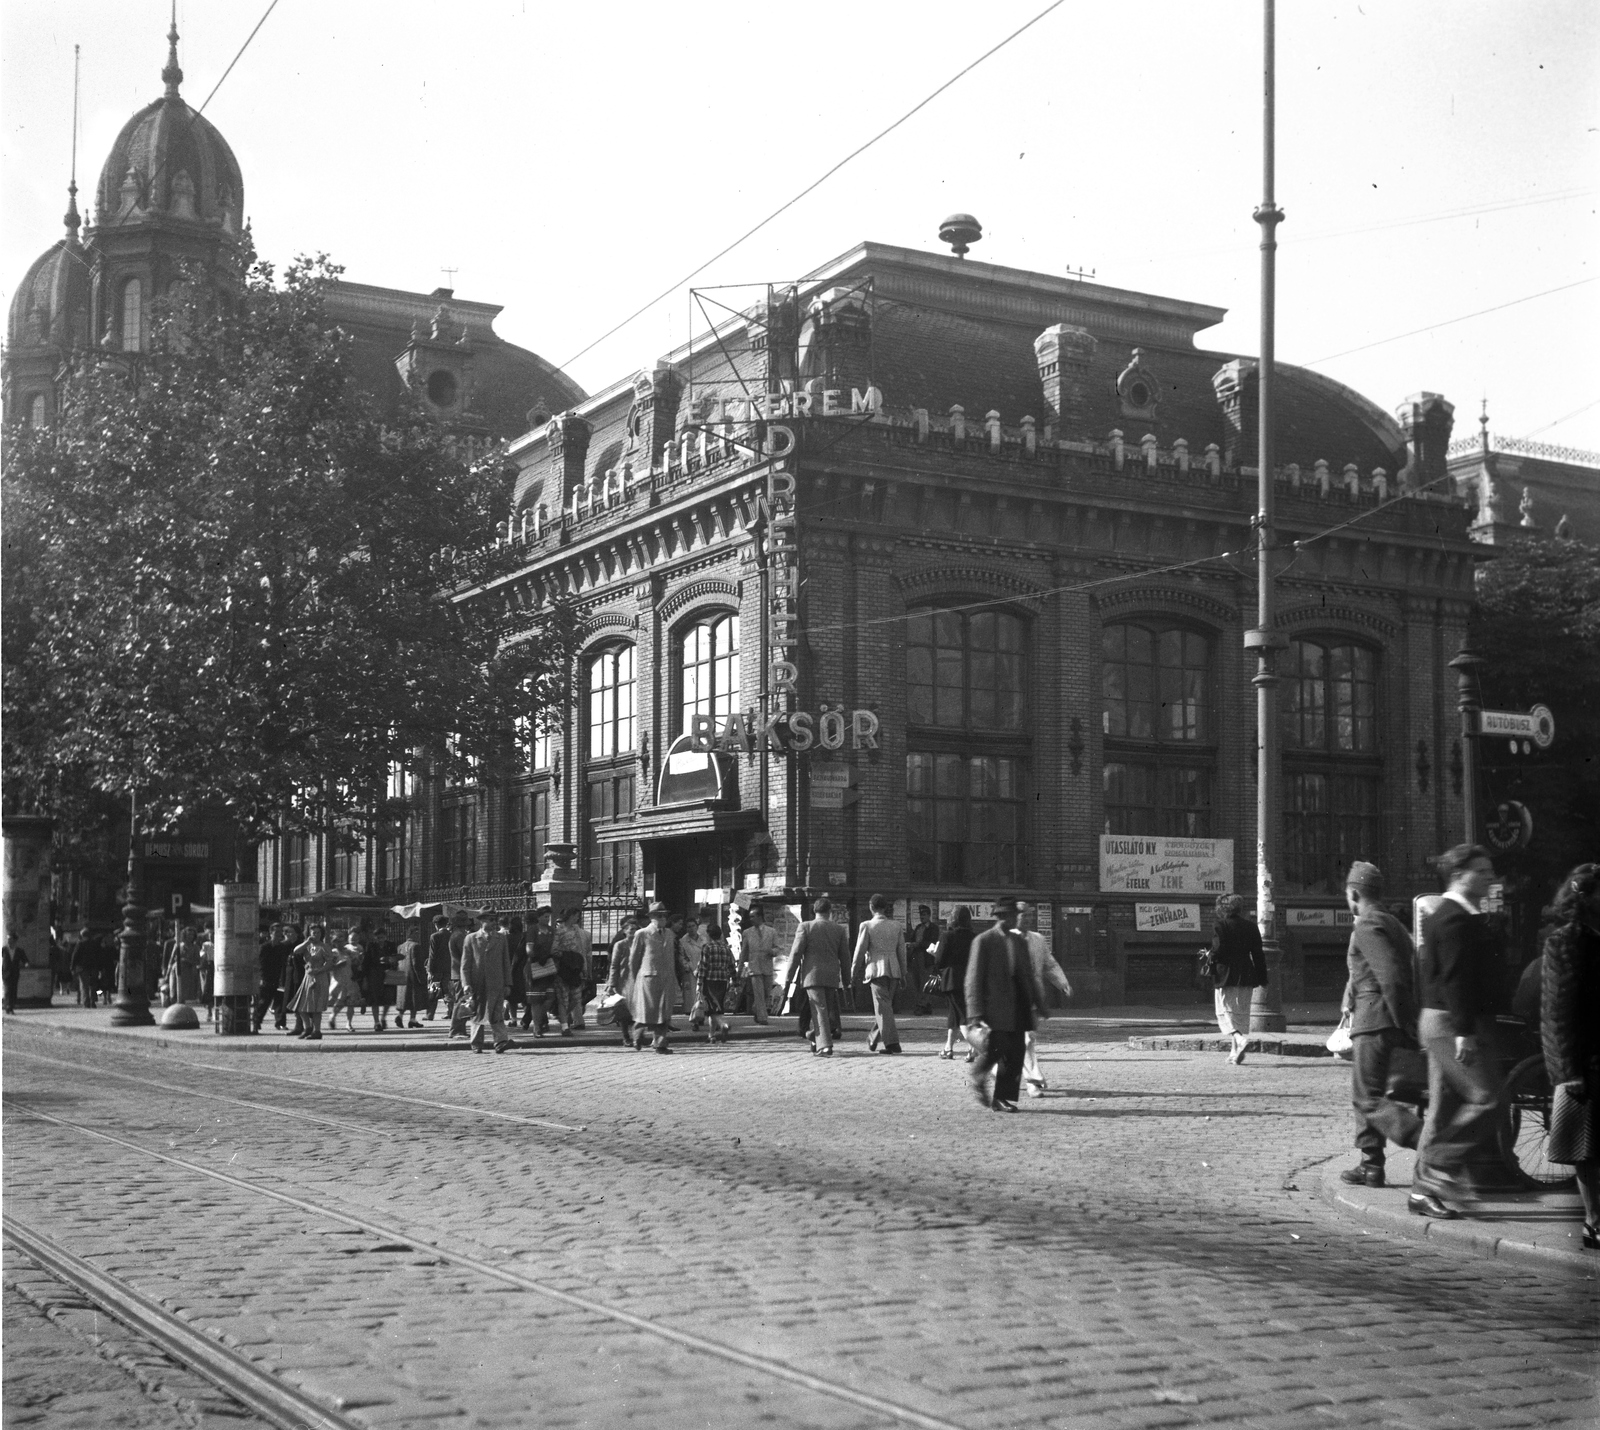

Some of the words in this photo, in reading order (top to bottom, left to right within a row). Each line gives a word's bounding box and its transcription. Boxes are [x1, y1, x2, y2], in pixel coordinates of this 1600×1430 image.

[767, 425, 798, 693] DREHER
[690, 703, 880, 752] BAKSÖR
[1105, 838, 1144, 855] UTASELÁTÓ
[1160, 875, 1184, 889] ZENE
[1204, 880, 1226, 891] FEKETE
[171, 894, 183, 914] P
